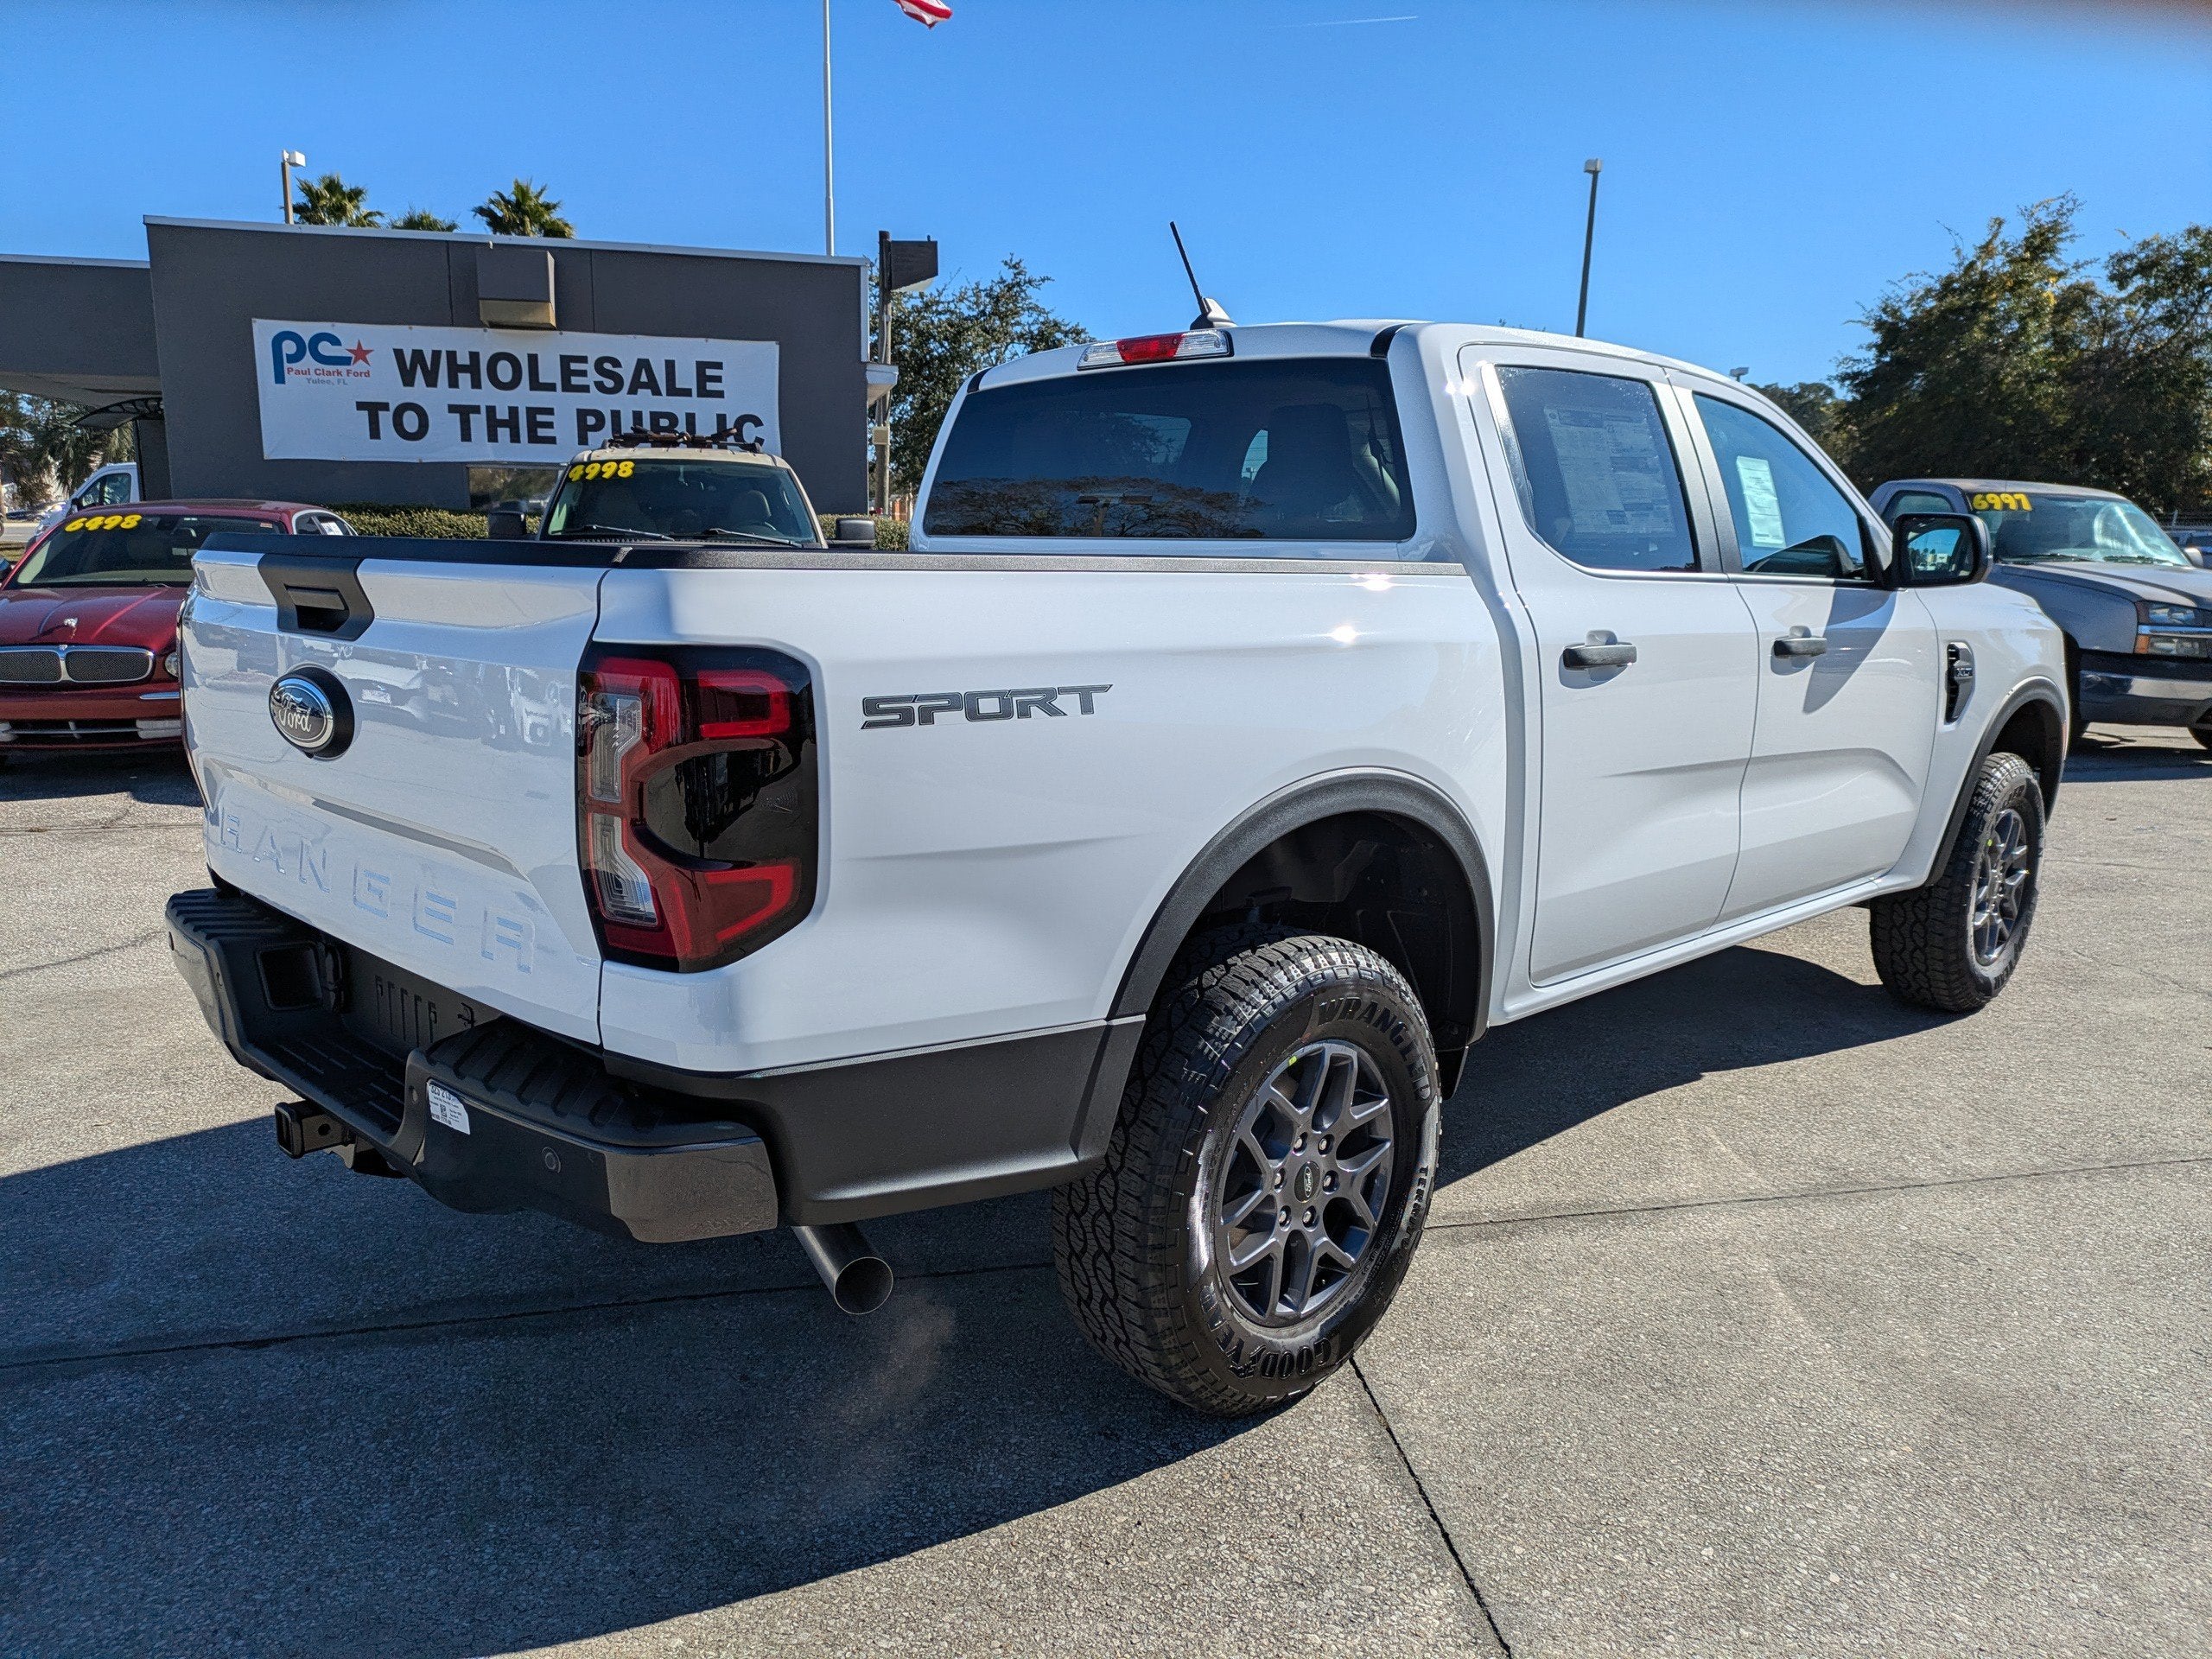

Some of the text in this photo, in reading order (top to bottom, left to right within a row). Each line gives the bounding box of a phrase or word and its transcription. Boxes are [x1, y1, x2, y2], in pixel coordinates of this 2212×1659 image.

[287, 367, 371, 378] Paul Clark Ford
[392, 347, 726, 399] WHOLESALE
[355, 400, 766, 449] TO THE PUBLIC
[1973, 493, 2033, 512] 6997
[277, 690, 312, 733] Ford
[861, 683, 1114, 730] SPORT
[219, 804, 536, 975] RANGER
[1318, 995, 1432, 1101] WRANGLER
[1199, 1281, 1332, 1380] GOODYEAR
